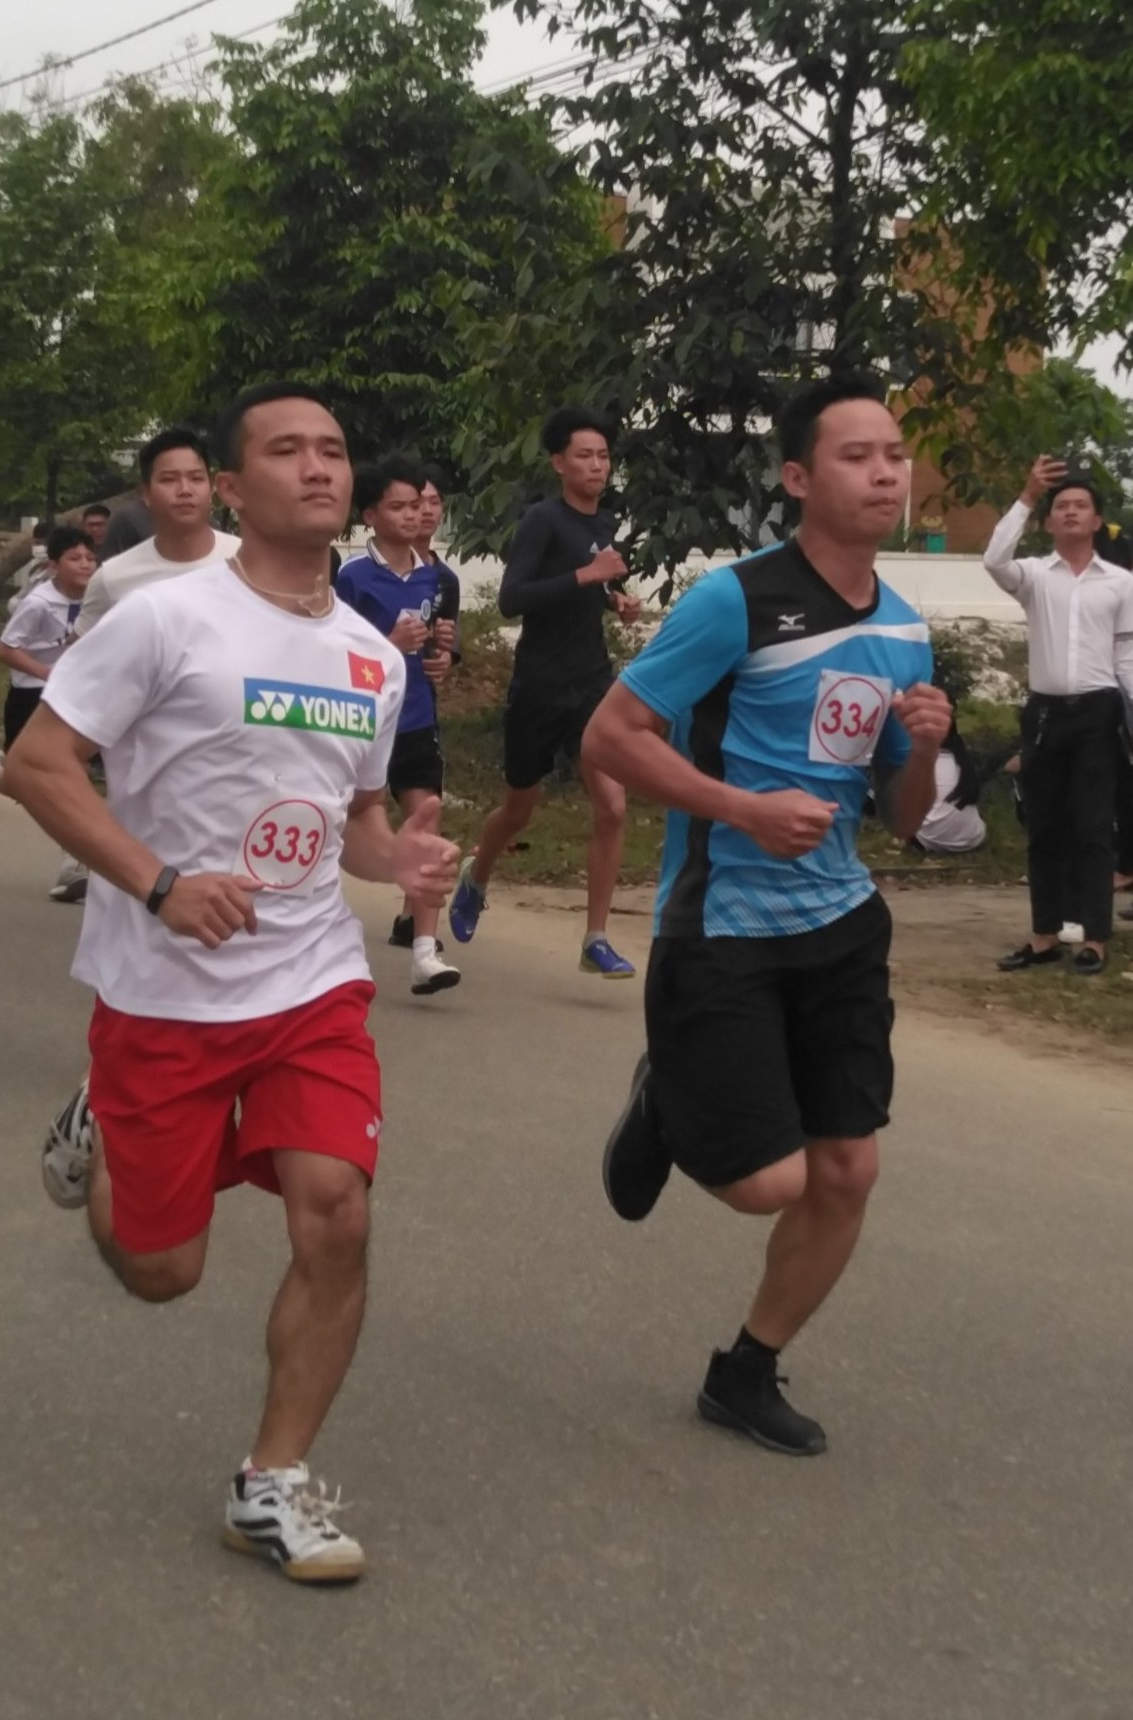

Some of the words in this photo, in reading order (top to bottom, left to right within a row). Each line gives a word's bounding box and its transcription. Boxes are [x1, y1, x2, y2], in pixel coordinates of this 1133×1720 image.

[299, 695, 370, 734] YONEX
[821, 700, 880, 738] 334
[251, 821, 320, 867] 333
